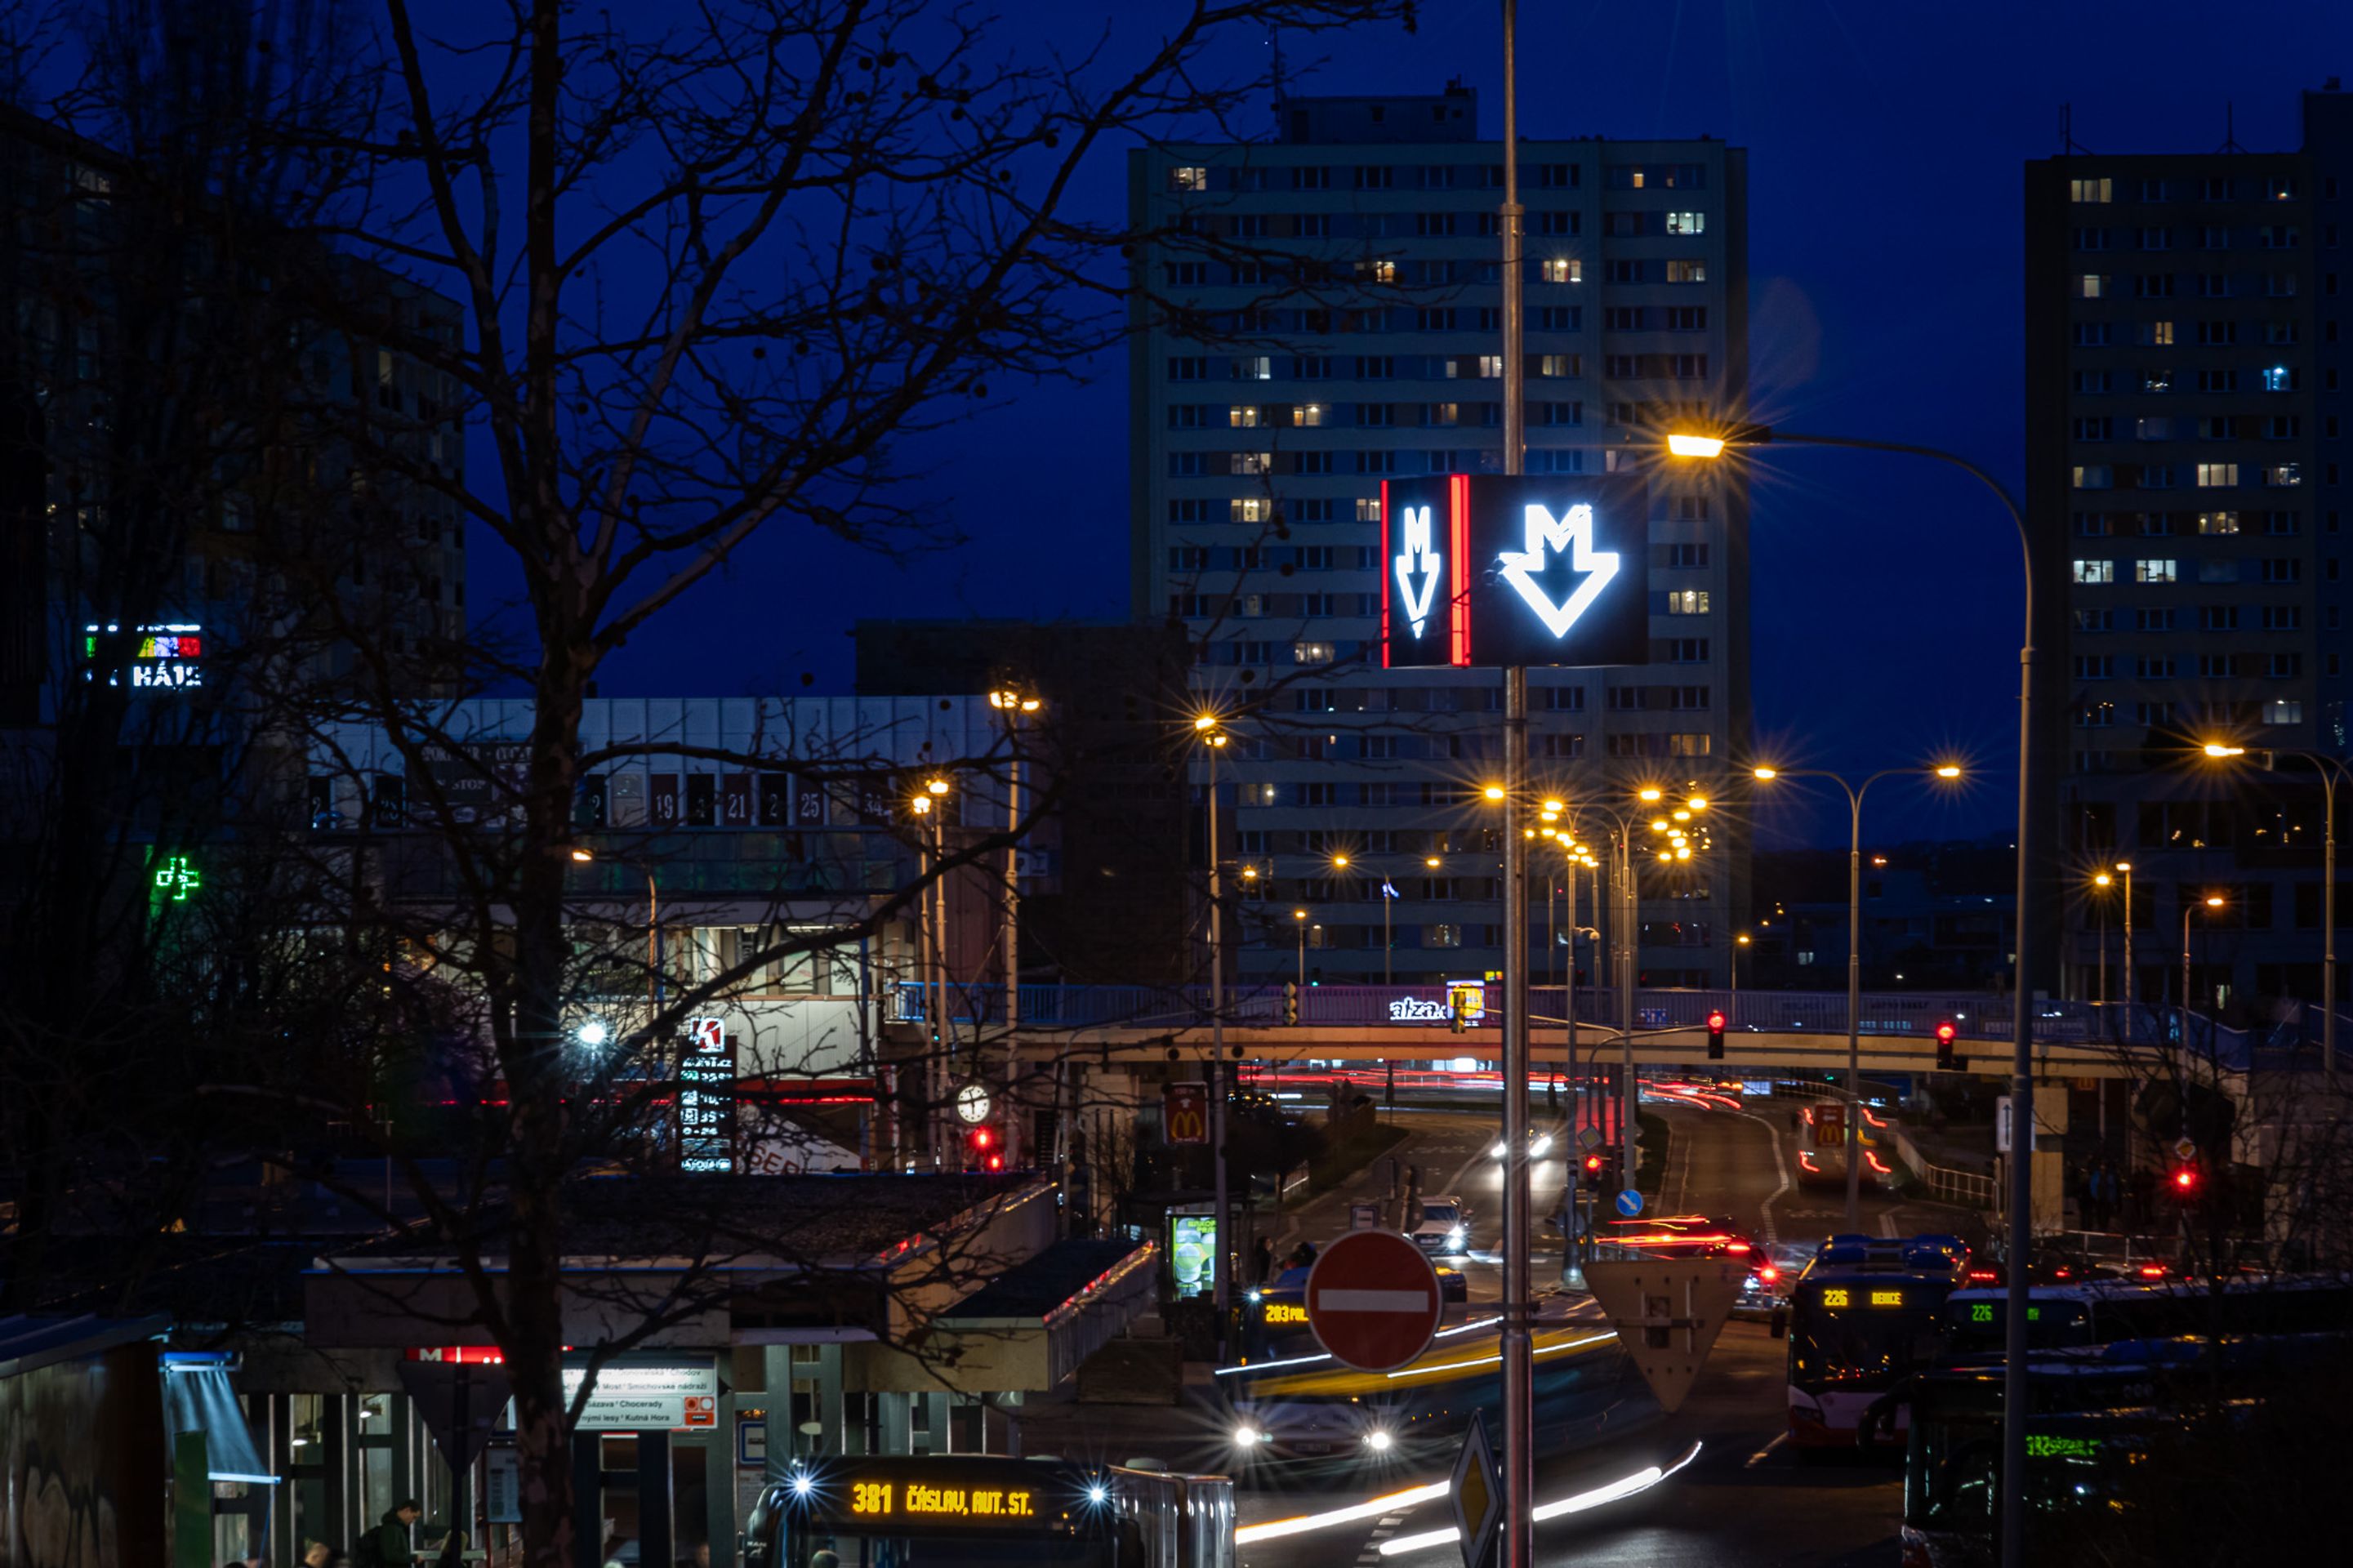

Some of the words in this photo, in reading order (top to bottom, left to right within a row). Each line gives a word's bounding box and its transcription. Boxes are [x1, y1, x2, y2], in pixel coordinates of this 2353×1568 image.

[656, 793, 673, 819] 19
[728, 793, 745, 818] 21
[801, 792, 820, 817] 25
[1824, 1290, 1847, 1307] 226
[1266, 1304, 1289, 1322] 203
[1972, 1304, 1994, 1322] 226
[619, 1399, 662, 1410] Chocerady
[625, 1414, 648, 1423] Kutná
[651, 1414, 670, 1423] Hora
[853, 1483, 892, 1513] 381
[907, 1485, 969, 1516] ČÁSLAV,
[1008, 1492, 1034, 1515] ST.
